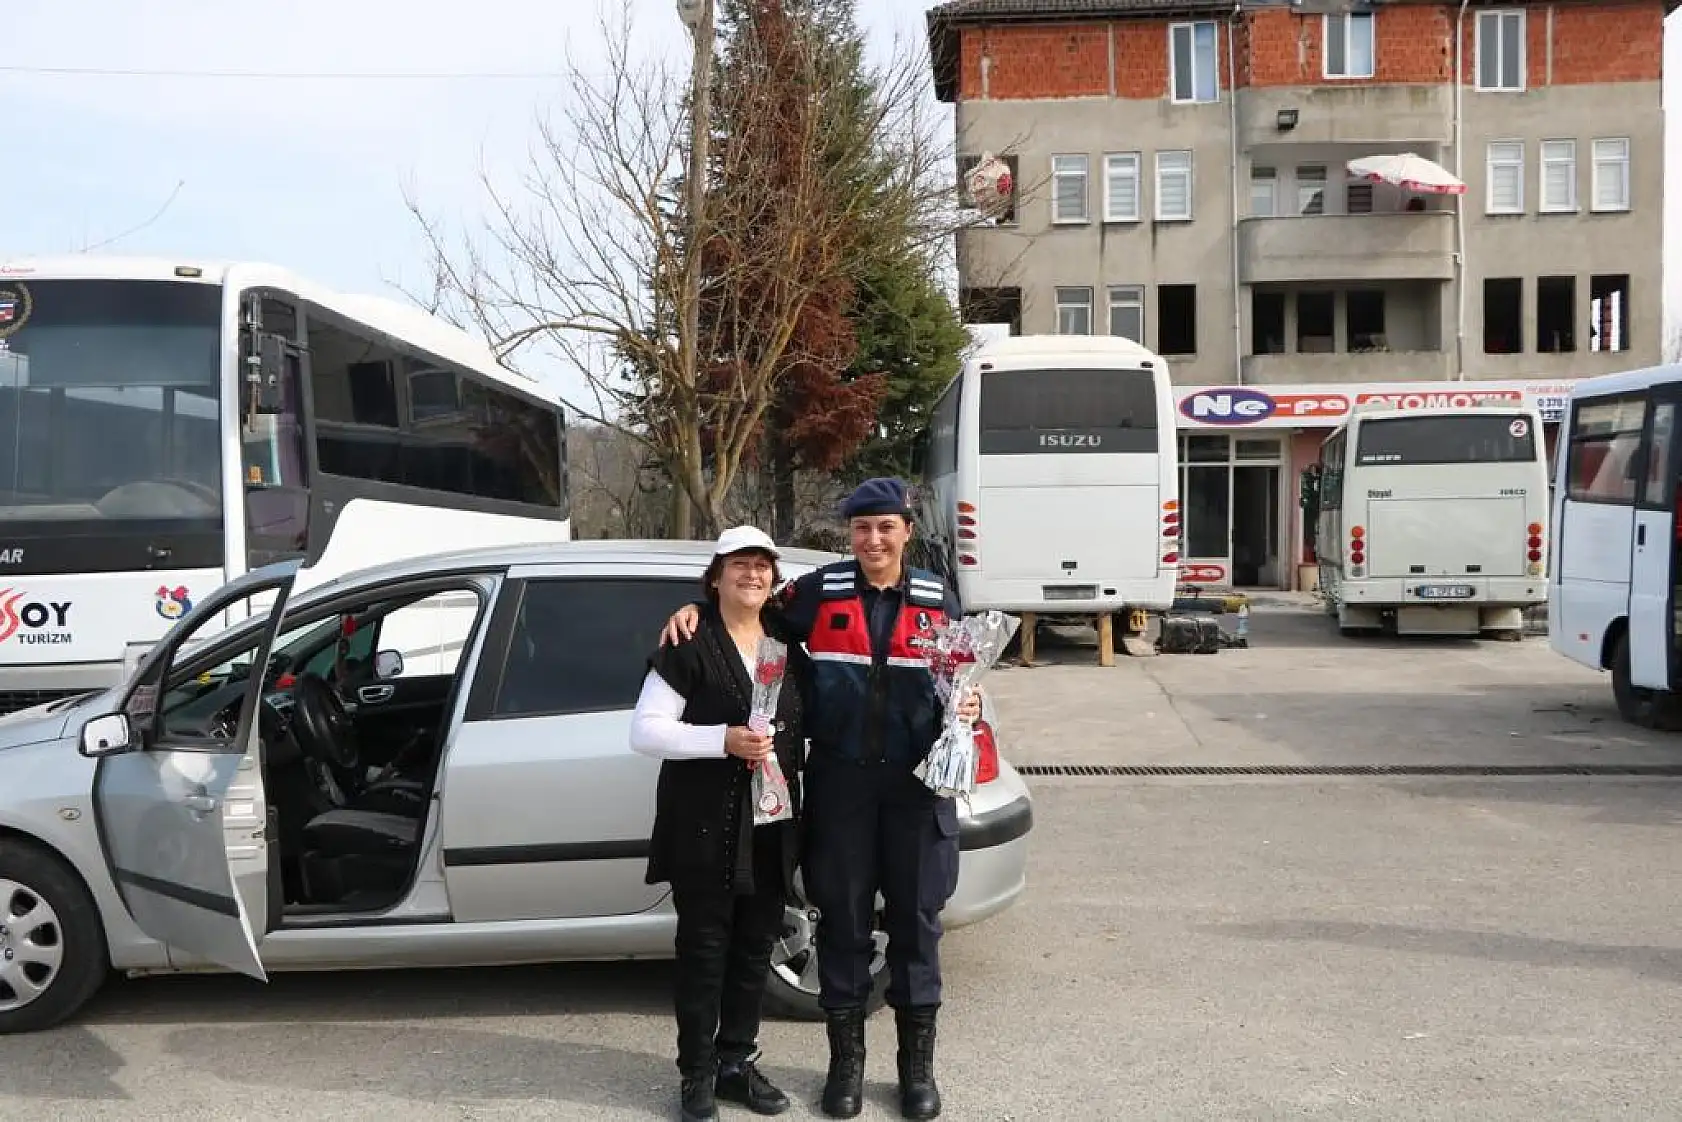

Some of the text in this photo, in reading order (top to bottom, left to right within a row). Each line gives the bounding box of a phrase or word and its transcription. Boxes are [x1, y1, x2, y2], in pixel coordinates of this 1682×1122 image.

[1513, 421, 1524, 434] 2
[1040, 434, 1101, 446] ISUZU
[17, 630, 72, 645] TURİZM
